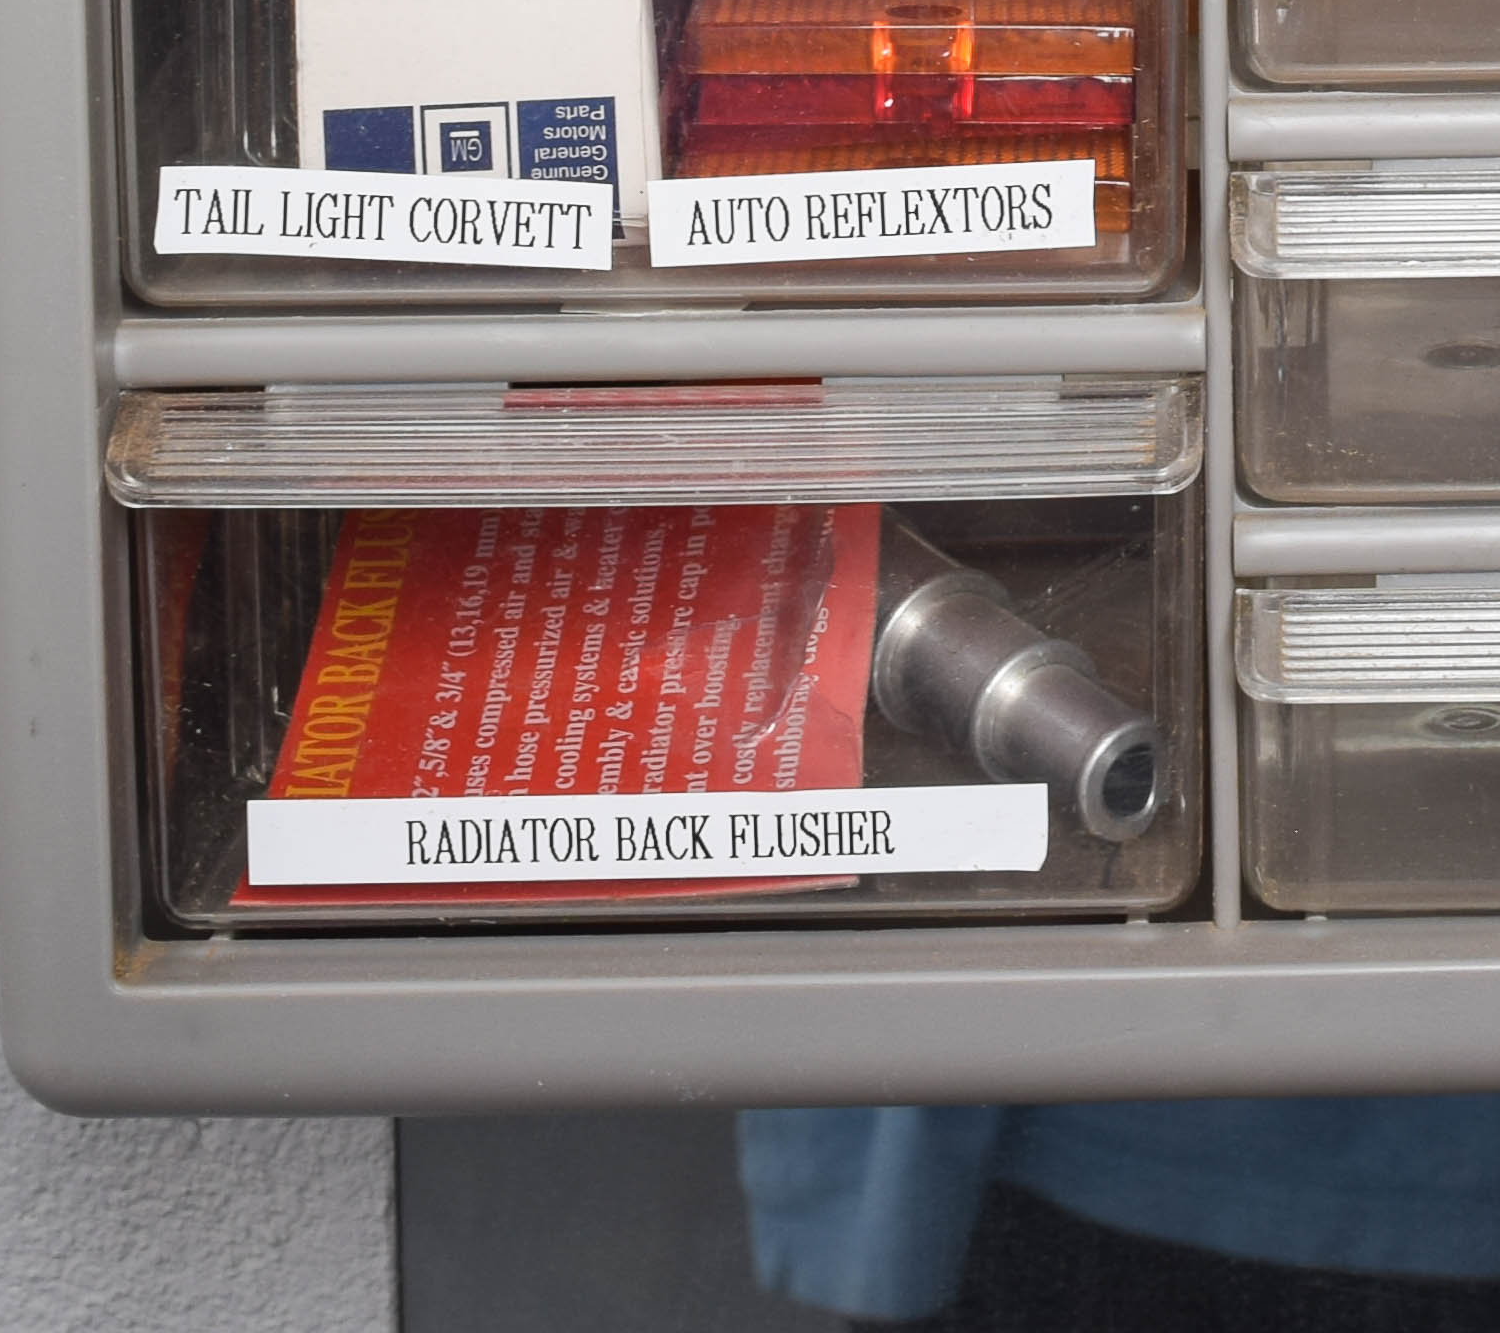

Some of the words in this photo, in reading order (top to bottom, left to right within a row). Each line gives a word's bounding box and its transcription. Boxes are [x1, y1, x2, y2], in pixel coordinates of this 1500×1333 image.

[555, 105, 605, 121] Parts
[450, 131, 483, 162] GM
[543, 125, 606, 141] Motors
[531, 165, 608, 180] Genuine
[534, 145, 607, 162] General
[174, 189, 264, 235] TAIL
[280, 191, 394, 240] LIGHT
[409, 197, 592, 249] CORVETT
[688, 197, 789, 245] AUTO
[804, 184, 1052, 240] REFLEXTORS
[510, 545, 536, 584] and
[556, 543, 579, 560] &
[684, 535, 707, 555] in
[549, 569, 573, 598] air
[677, 562, 708, 600] cap
[502, 591, 527, 619] air
[585, 599, 609, 616] &
[317, 597, 398, 685] BACK
[743, 582, 784, 713] replacement
[524, 606, 567, 724] pressurized
[572, 623, 606, 702] systems
[474, 627, 520, 748] compressed
[607, 701, 633, 720] &
[505, 732, 539, 781] hose
[555, 709, 594, 789] cooling
[640, 702, 676, 793] radiator
[687, 715, 717, 764] over
[406, 818, 599, 865] RADIATOR
[615, 815, 713, 861] BACK
[729, 811, 895, 858] FLUSHER
